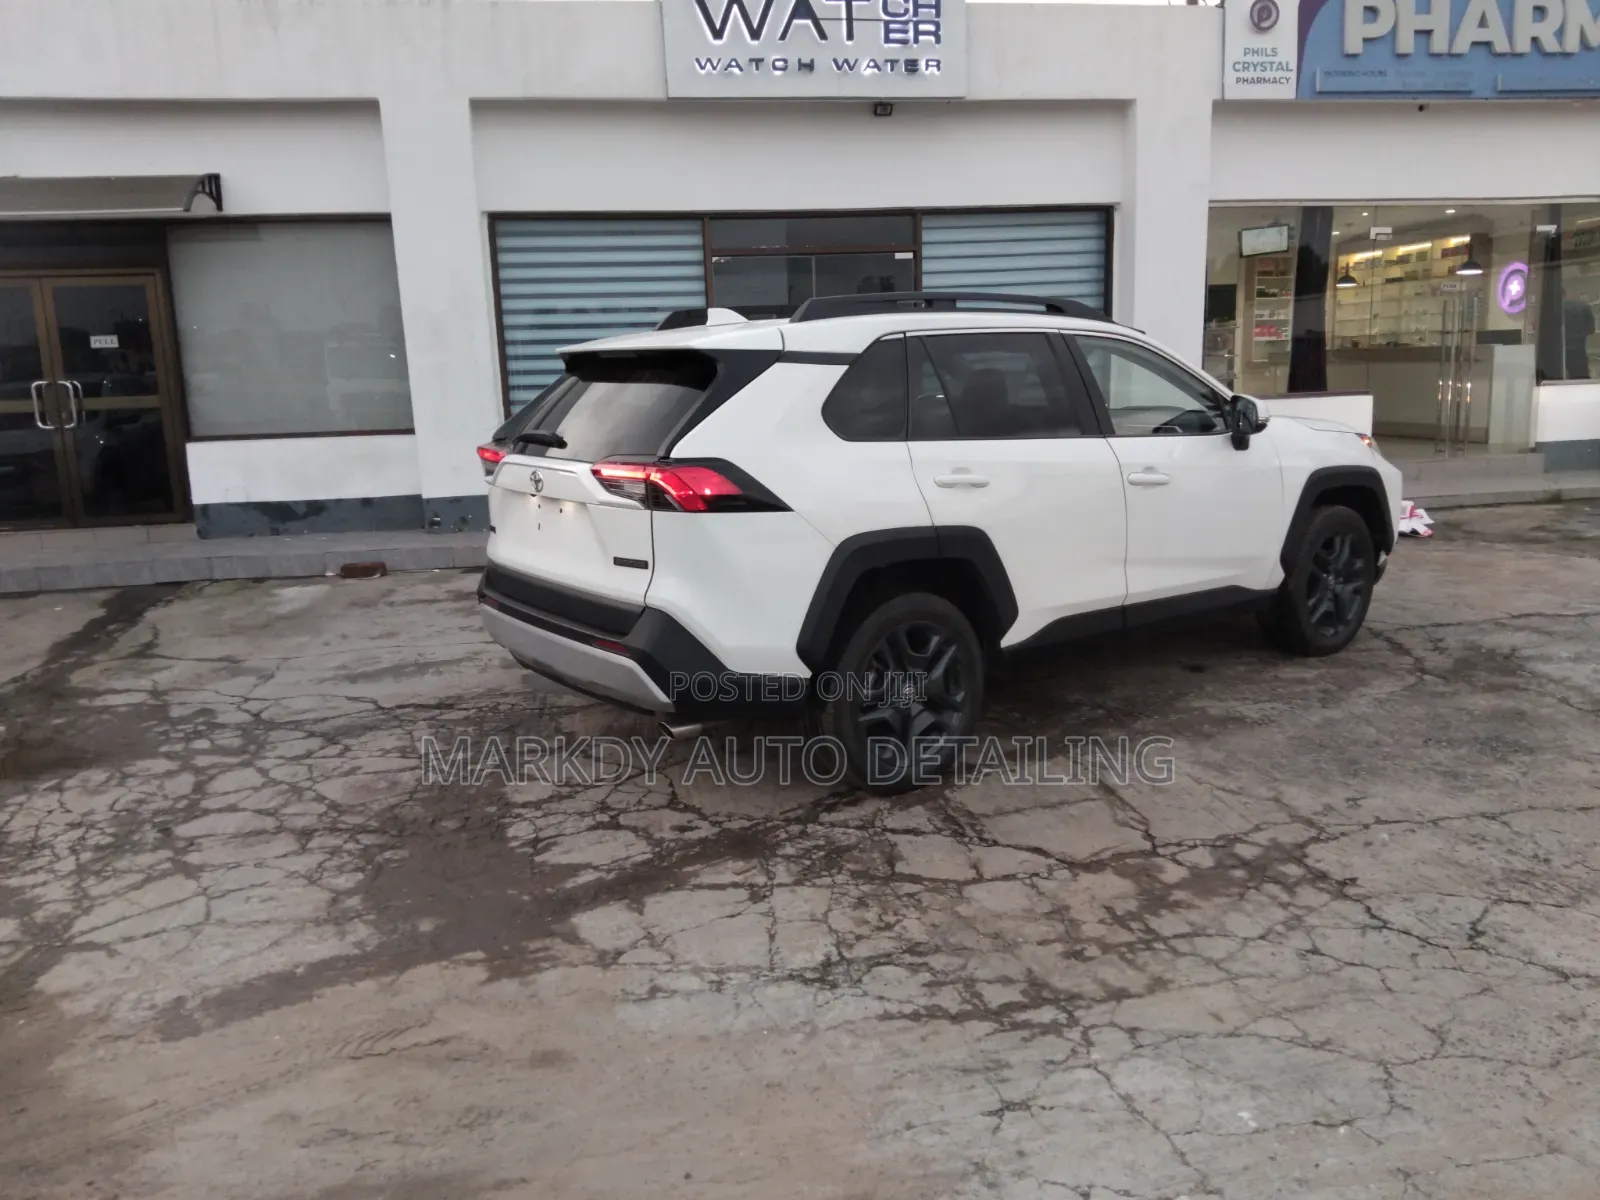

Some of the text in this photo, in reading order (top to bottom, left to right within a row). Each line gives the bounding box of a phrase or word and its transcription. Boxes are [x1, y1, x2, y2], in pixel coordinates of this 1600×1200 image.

[882, 19, 942, 45] ER
[1243, 47, 1278, 57] PHILS
[695, 57, 942, 73] WATCH WATER
[1232, 61, 1293, 73] CRYSTAL
[1235, 76, 1291, 85] PHARMACY
